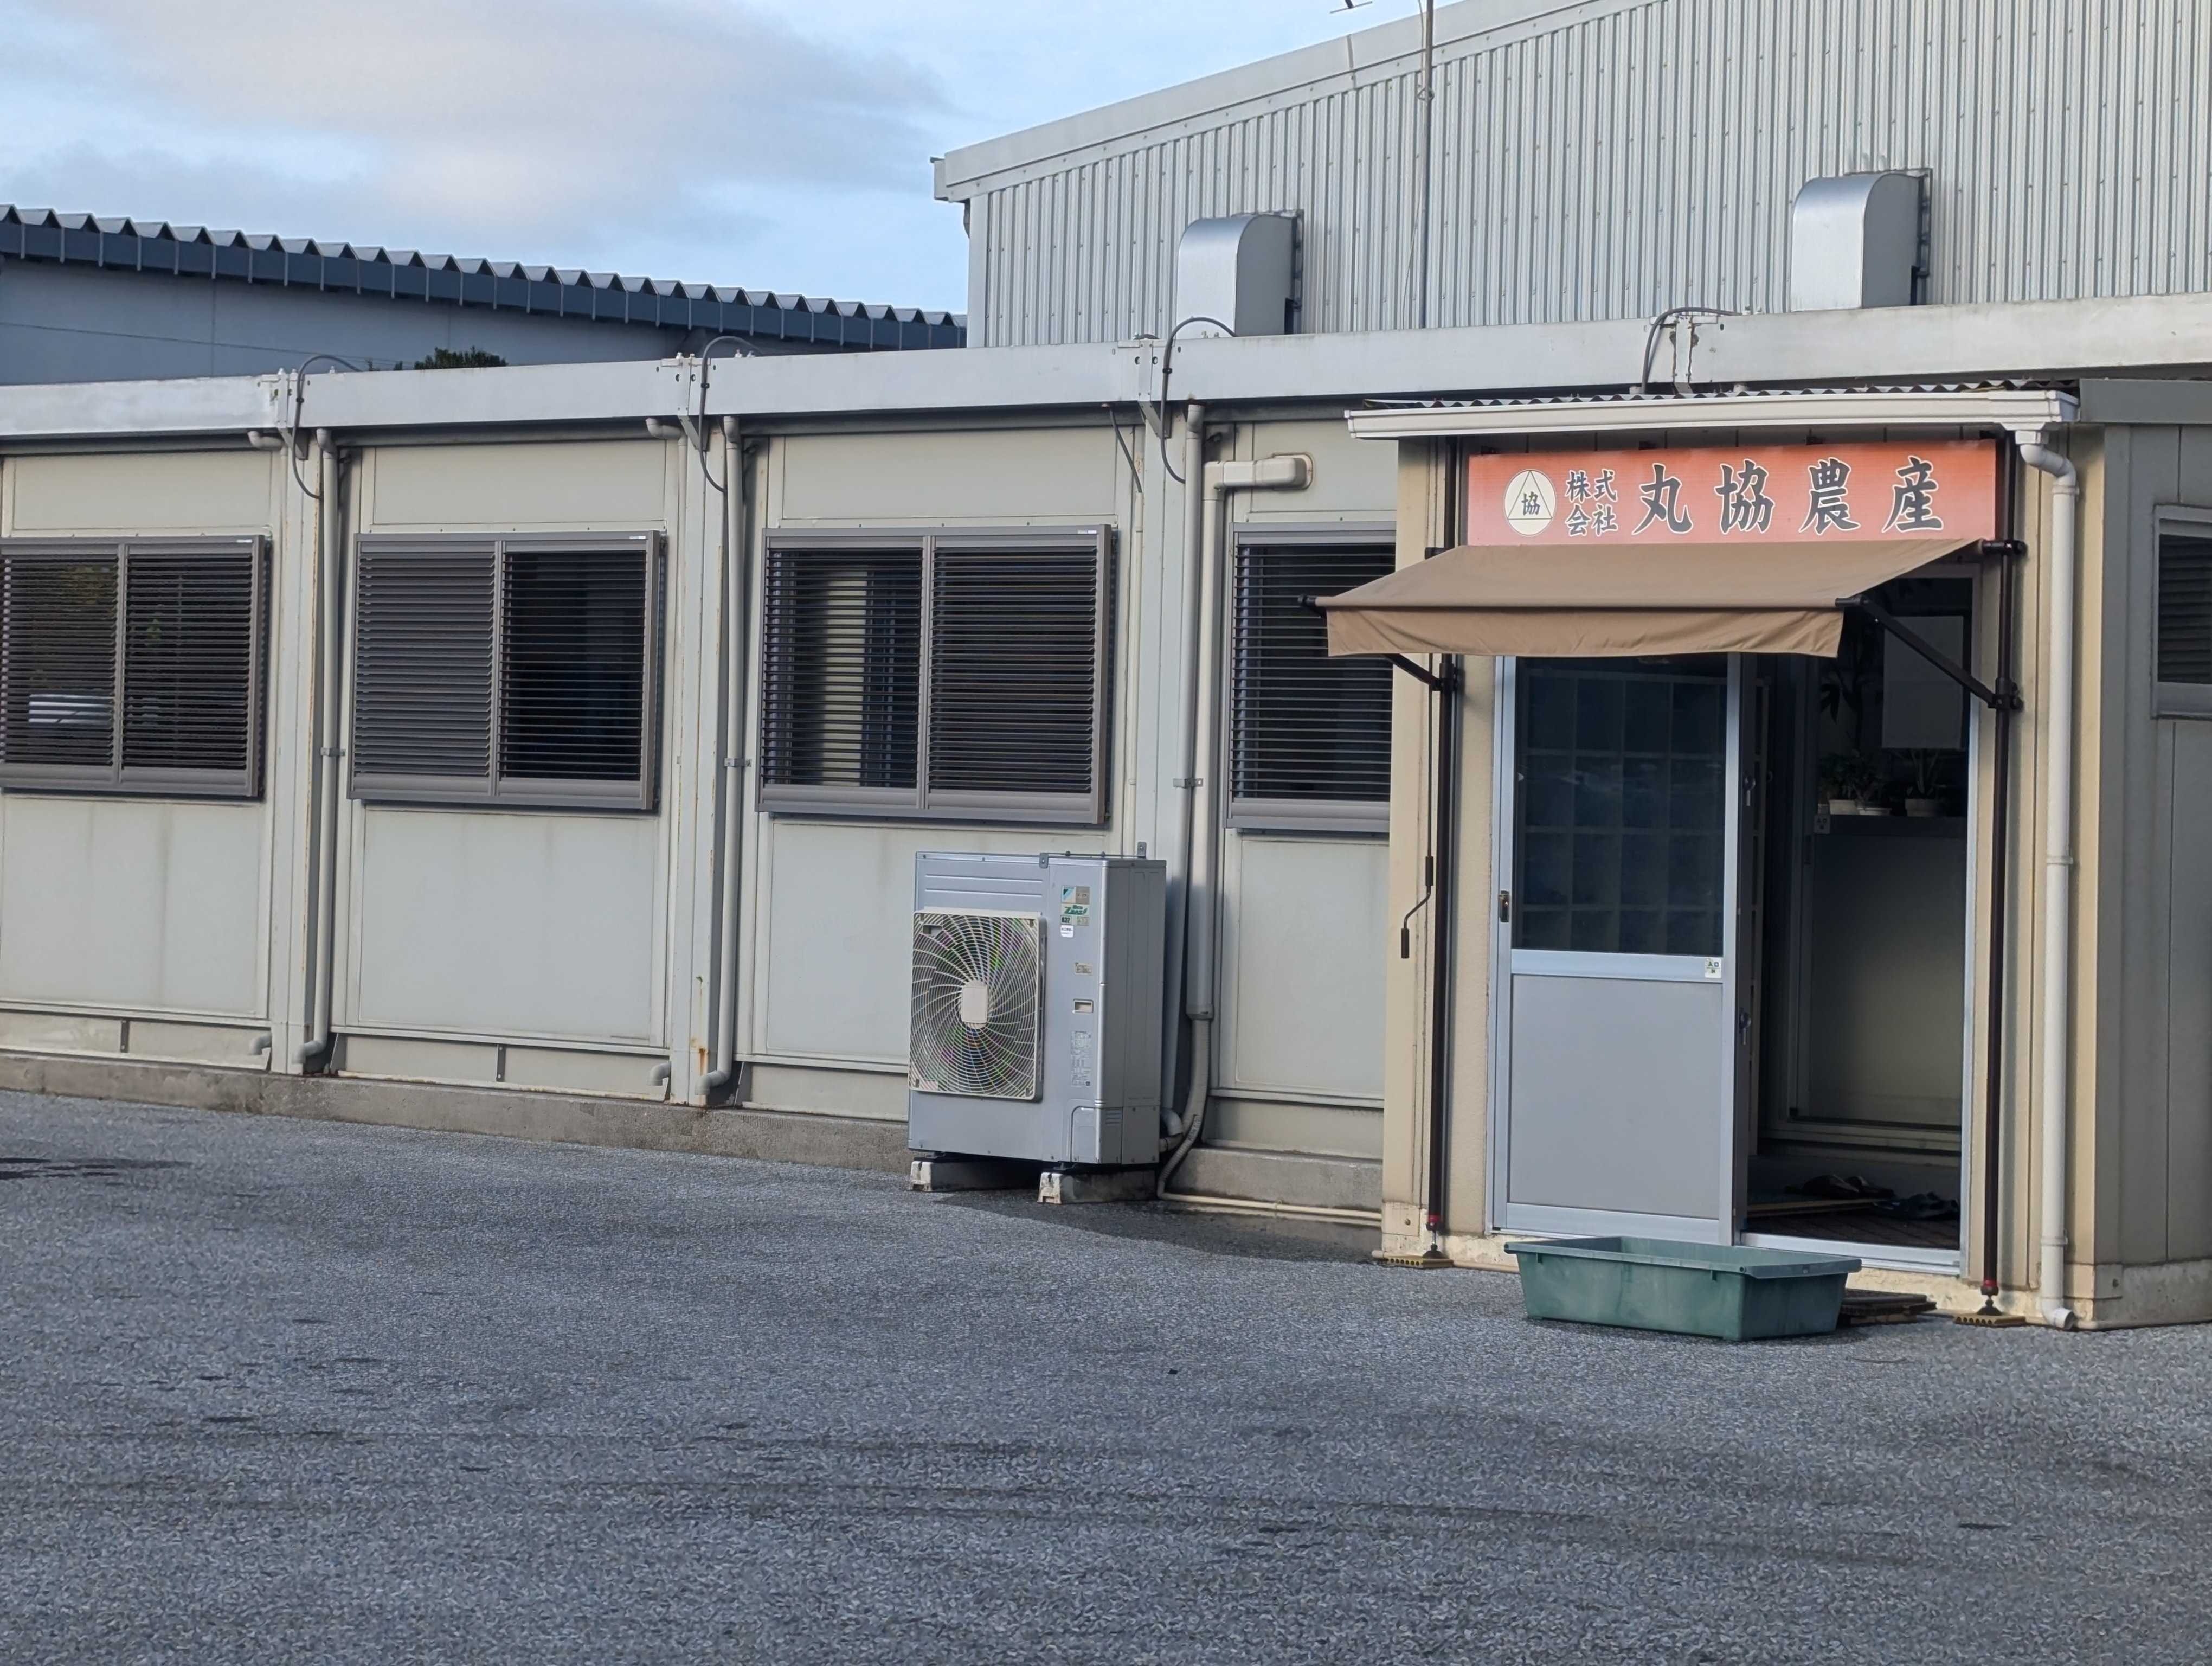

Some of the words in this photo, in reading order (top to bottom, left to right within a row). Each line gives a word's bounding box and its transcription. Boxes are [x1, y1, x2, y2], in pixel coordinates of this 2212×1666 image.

[1565, 469, 1618, 503] 株式
[1631, 456, 1944, 536] 丸協農産
[1521, 491, 1540, 516] 協
[1565, 503, 1618, 536] 会社
